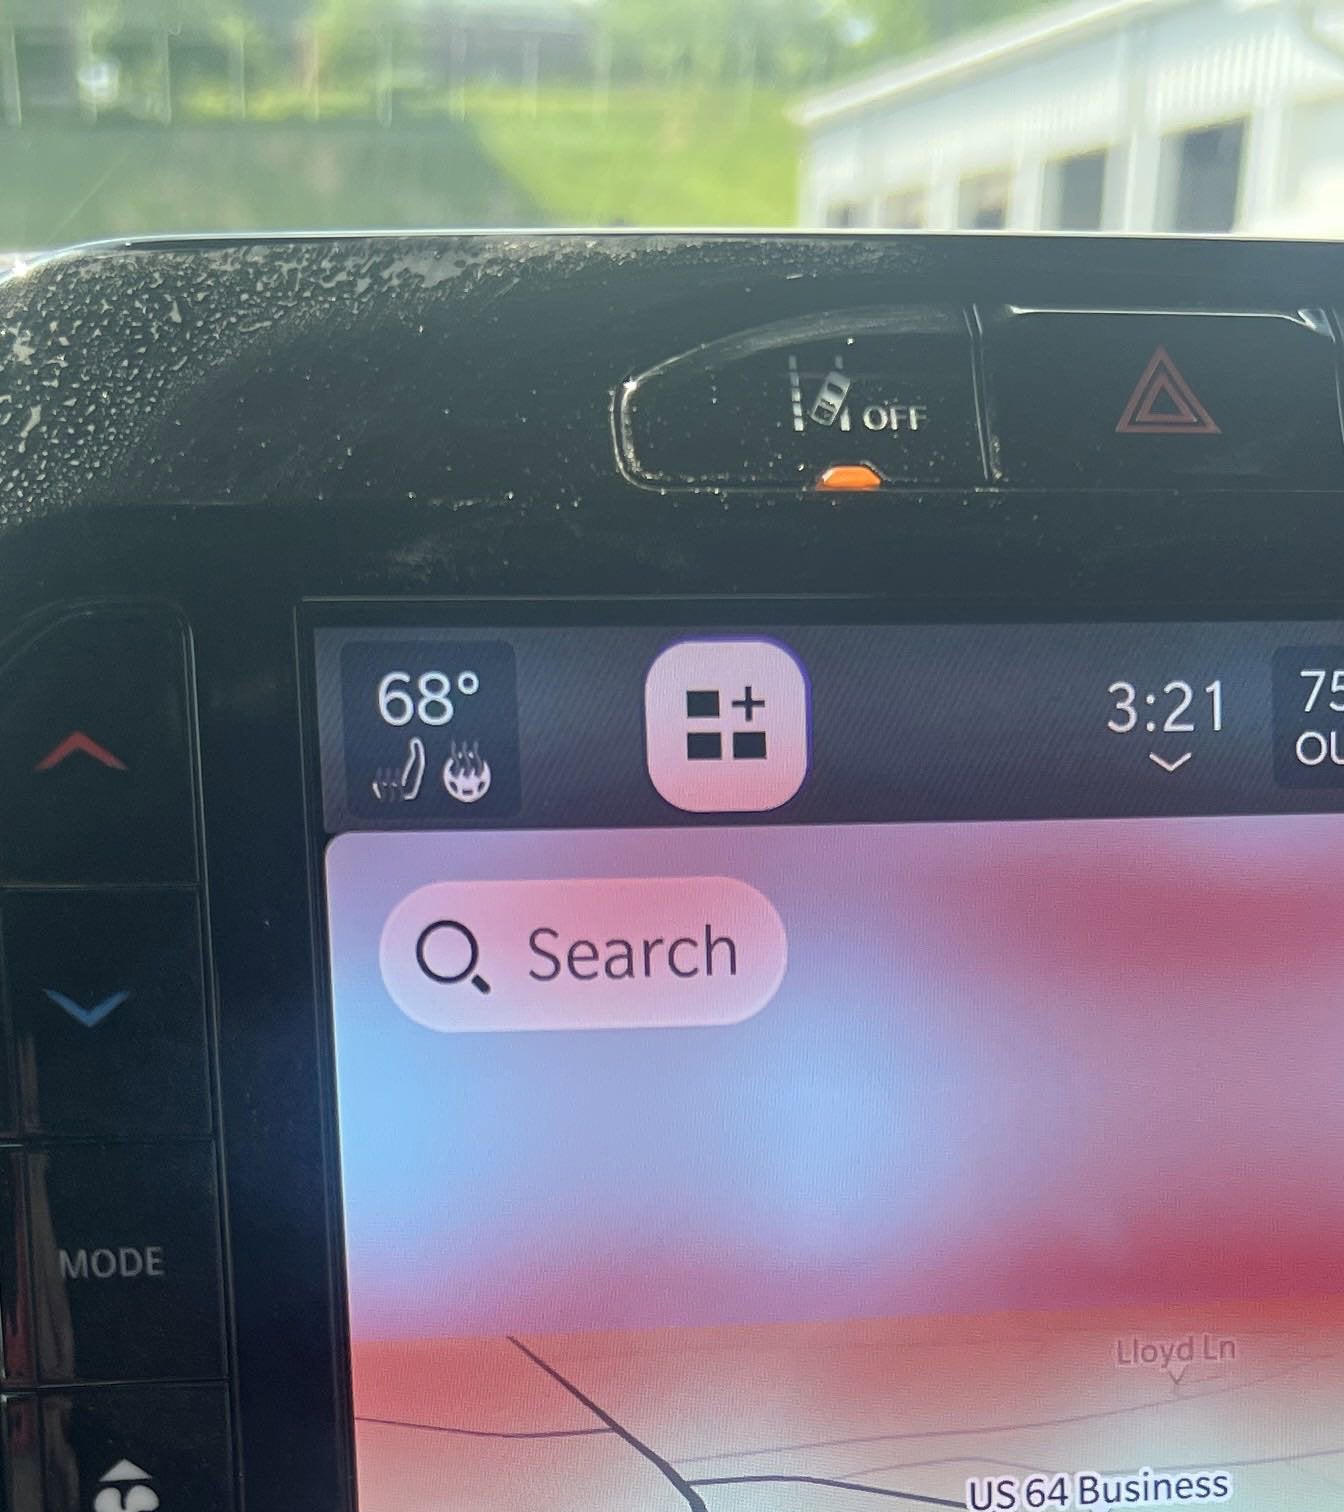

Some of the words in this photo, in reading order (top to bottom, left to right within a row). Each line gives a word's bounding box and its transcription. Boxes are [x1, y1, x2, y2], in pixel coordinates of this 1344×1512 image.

[863, 405, 929, 431] OFF
[377, 671, 480, 726] 68°
[1107, 680, 1223, 734] 3:21
[528, 924, 738, 982] Search
[60, 1246, 165, 1279] MODE
[1118, 1335, 1193, 1368] Lloyd
[1203, 1335, 1236, 1361] Ln
[970, 1480, 1017, 1512] US
[1027, 1476, 1069, 1508] 64
[1079, 1471, 1229, 1505] Business
